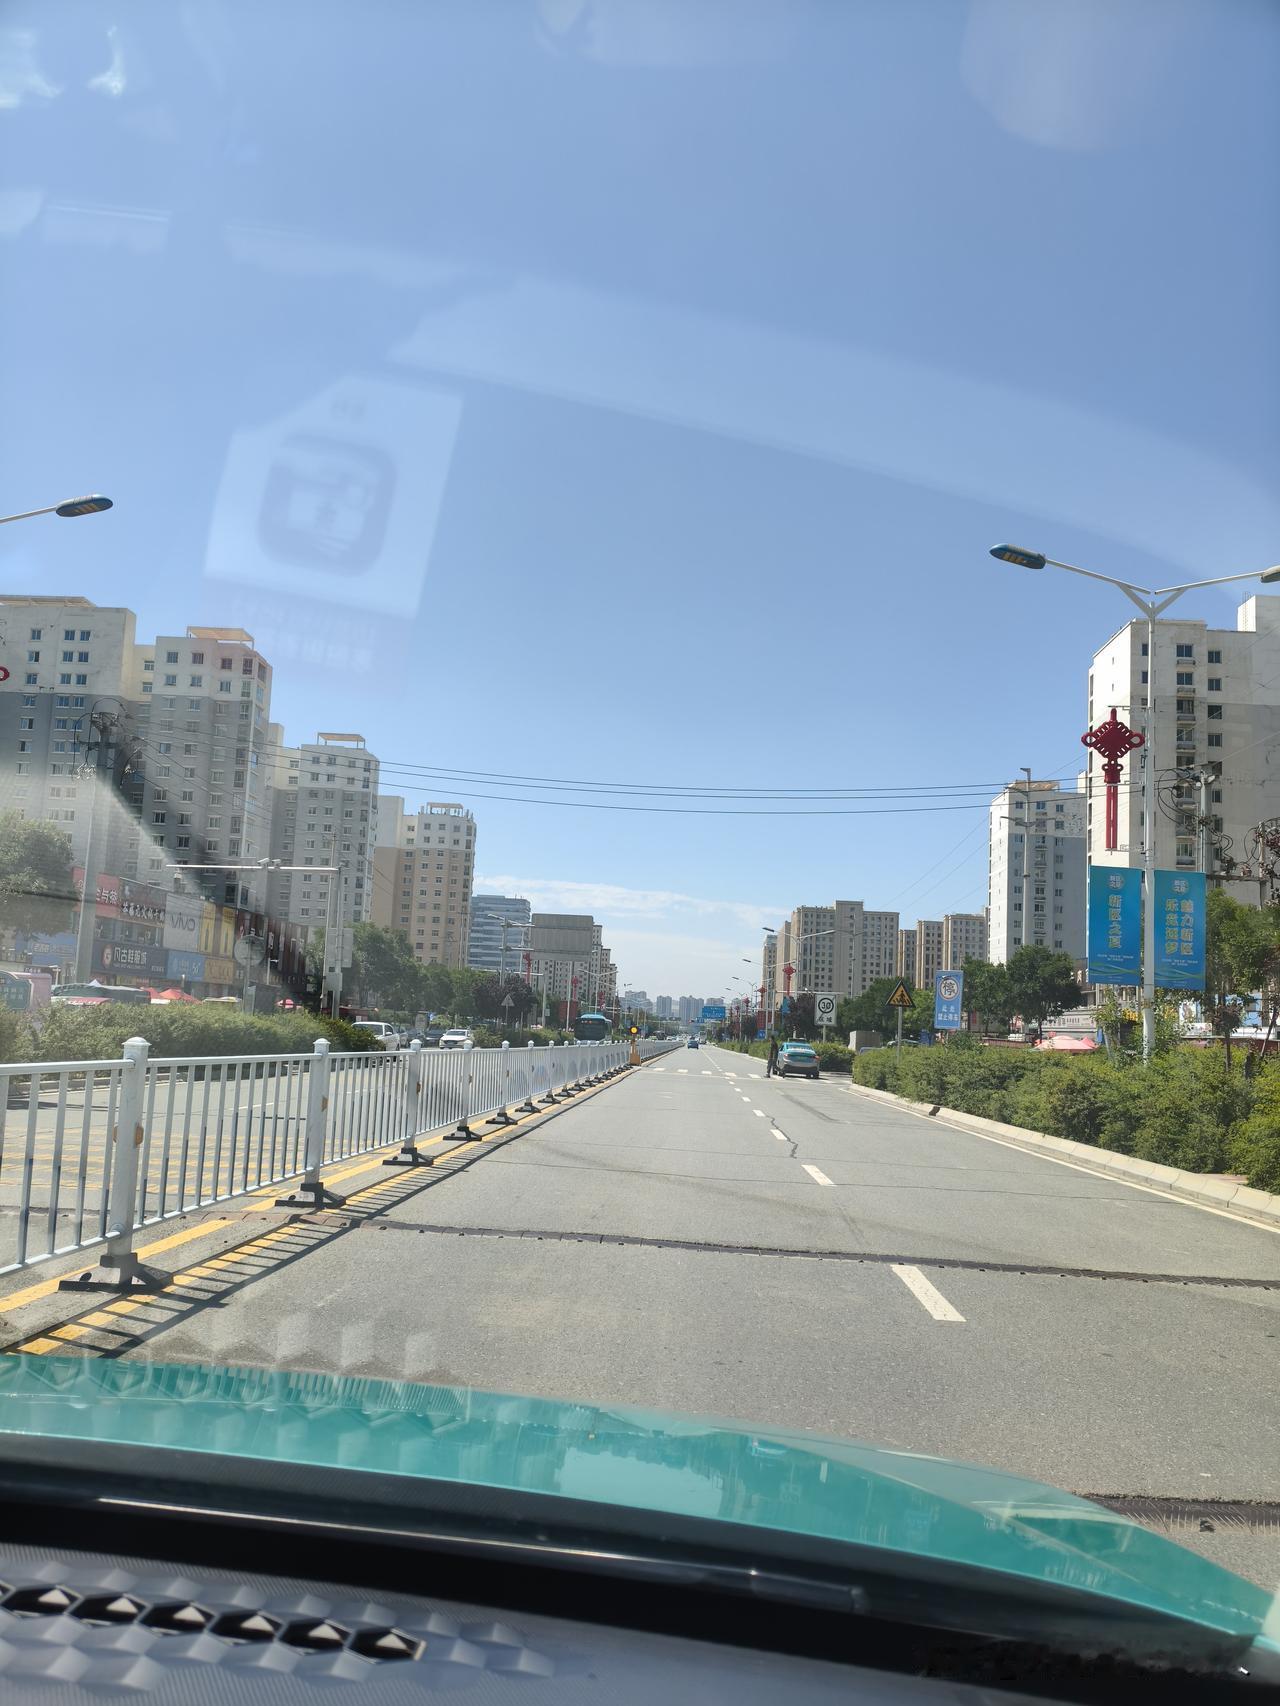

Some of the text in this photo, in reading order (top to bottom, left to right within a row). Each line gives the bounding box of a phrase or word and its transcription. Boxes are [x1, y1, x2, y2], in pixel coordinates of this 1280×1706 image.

[171, 912, 196, 931] vivo
[1108, 894, 1122, 948] 新区之夏
[1180, 899, 1194, 955] 魅力新区
[942, 980, 956, 996] 停
[821, 1001, 831, 1010] 30
